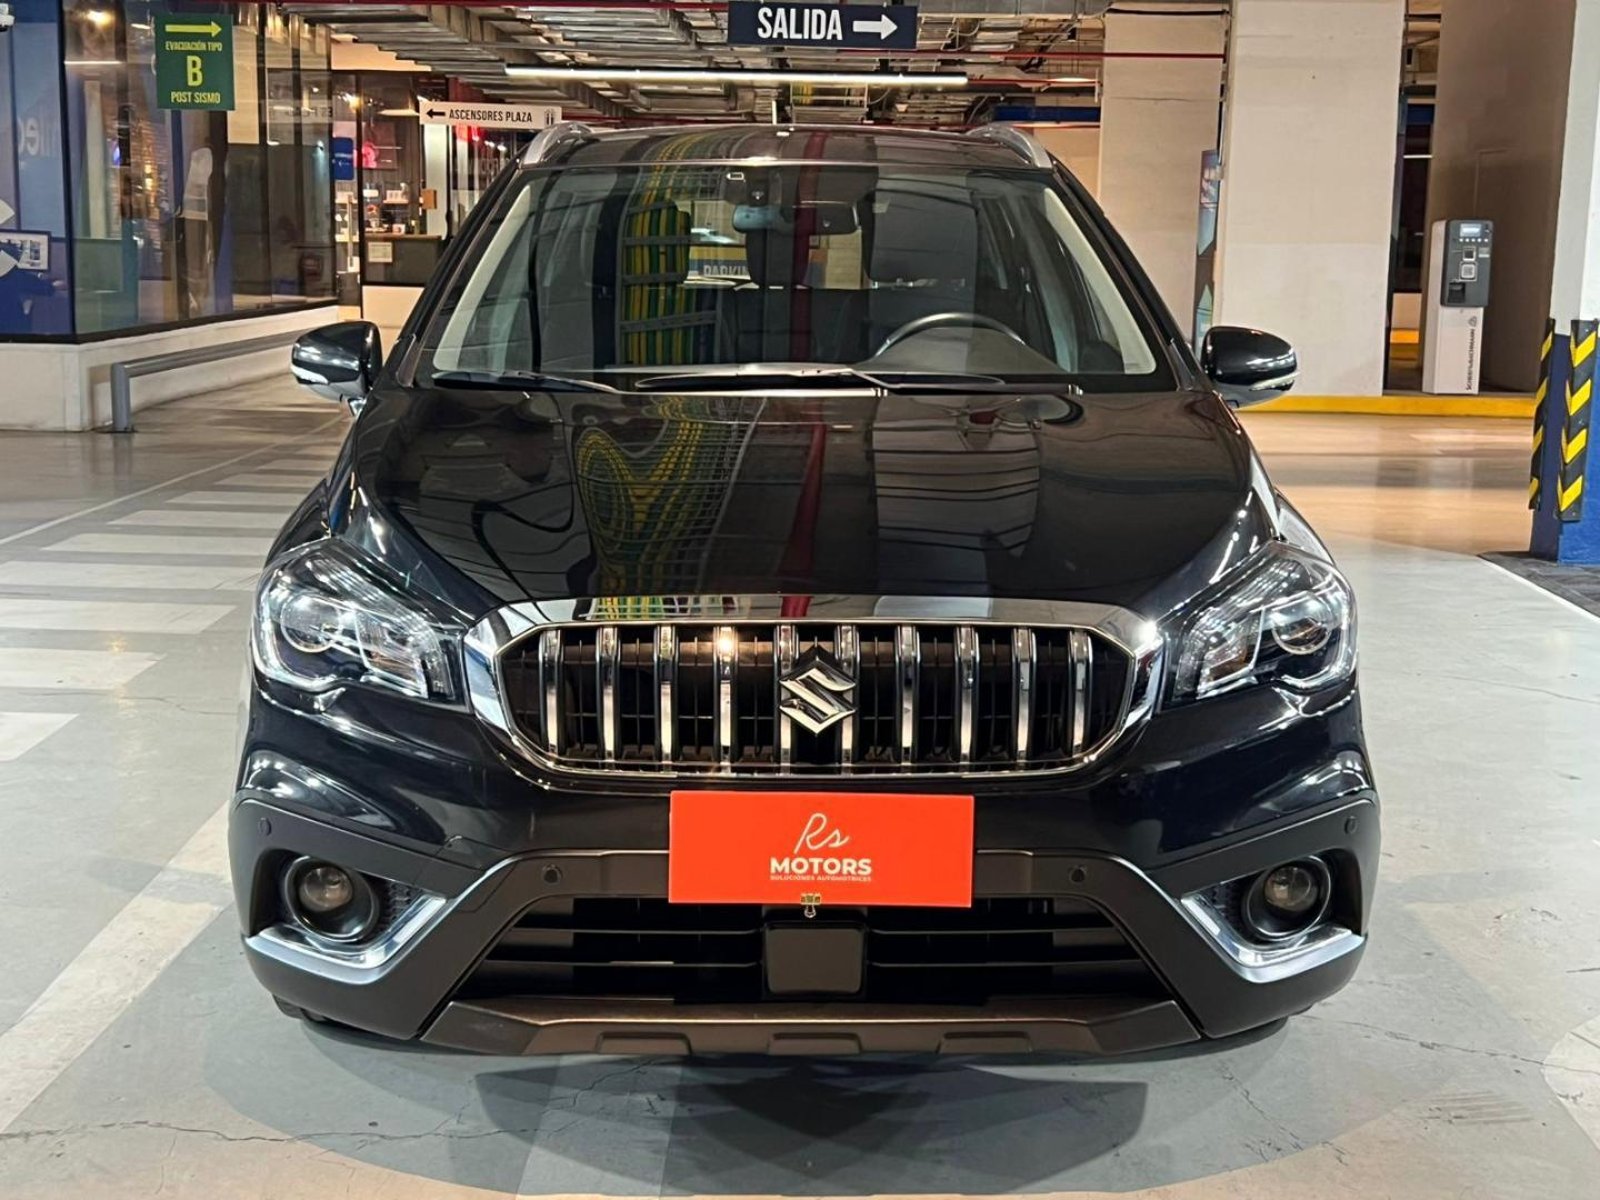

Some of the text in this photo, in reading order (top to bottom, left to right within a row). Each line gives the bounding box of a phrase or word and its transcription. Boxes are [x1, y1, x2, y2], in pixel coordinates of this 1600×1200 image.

[757, 7, 843, 41] SALIDA
[207, 41, 222, 52] TIPO
[186, 55, 203, 87] B
[170, 91, 221, 104] POST SISMO
[449, 109, 533, 123] ASCENSORES PLAZA
[793, 812, 850, 854] Rs
[770, 857, 872, 876] MOTORS
